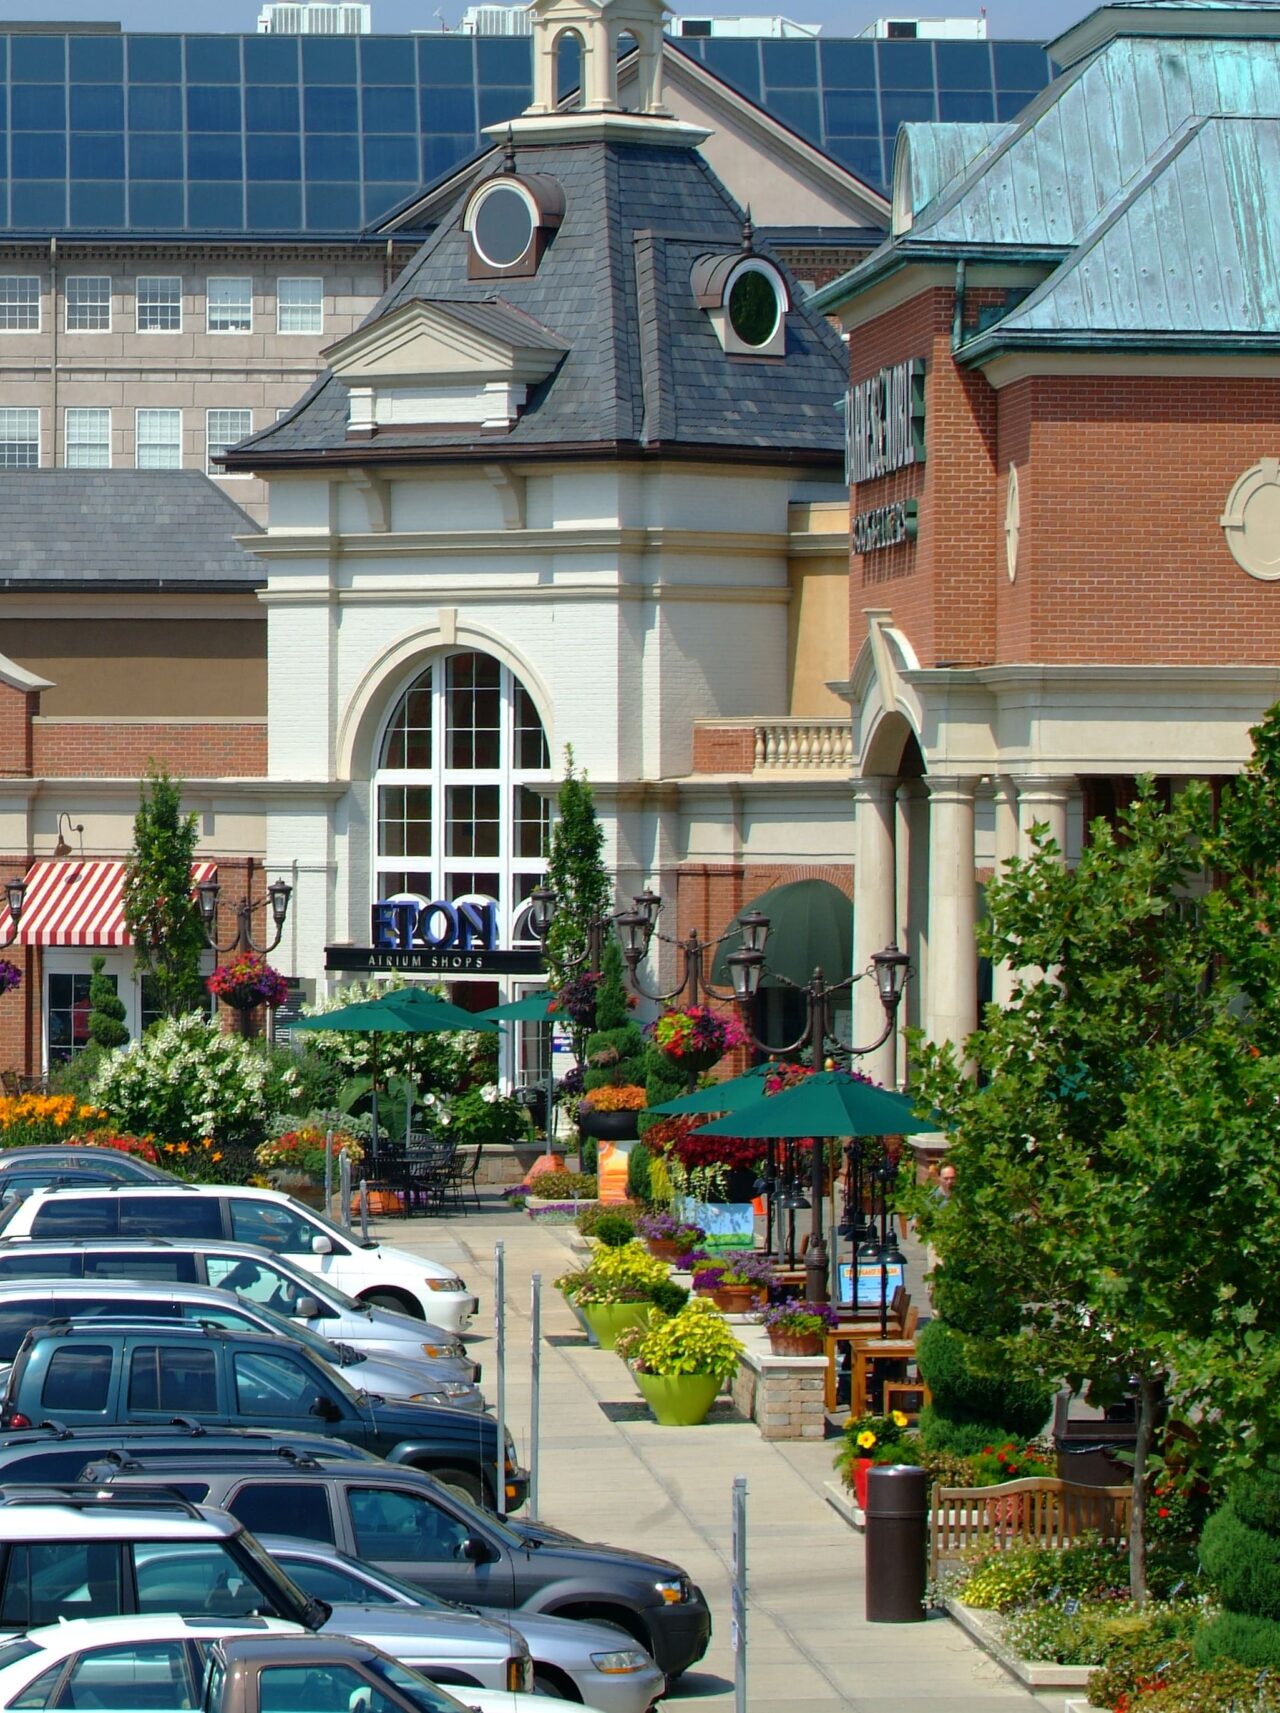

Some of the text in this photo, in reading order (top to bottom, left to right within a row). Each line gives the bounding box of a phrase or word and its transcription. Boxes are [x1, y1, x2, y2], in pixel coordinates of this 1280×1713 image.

[372, 899, 497, 950] ETON
[368, 954, 484, 968] ATRIUM SHOPS
